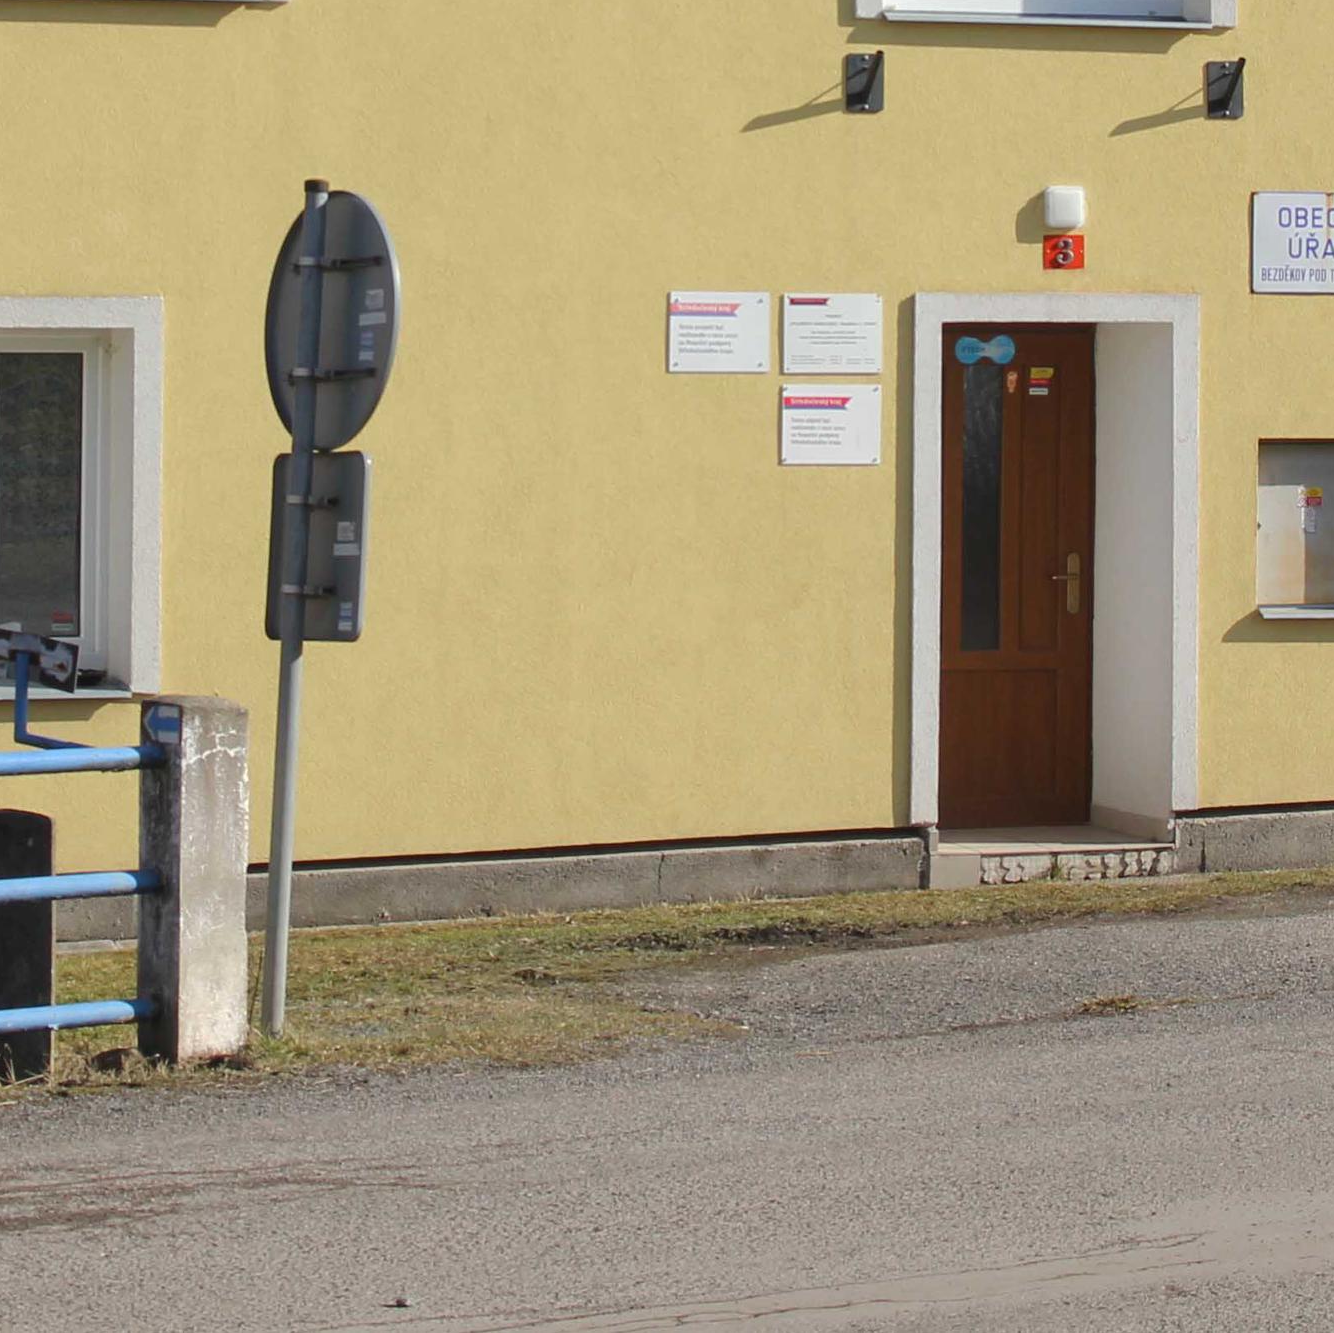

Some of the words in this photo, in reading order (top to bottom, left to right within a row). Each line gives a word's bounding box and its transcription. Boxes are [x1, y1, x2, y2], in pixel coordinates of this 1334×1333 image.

[1056, 237, 1074, 265] 3
[1261, 265, 1306, 282] BEZDĚKOV
[1309, 268, 1327, 282] POD
